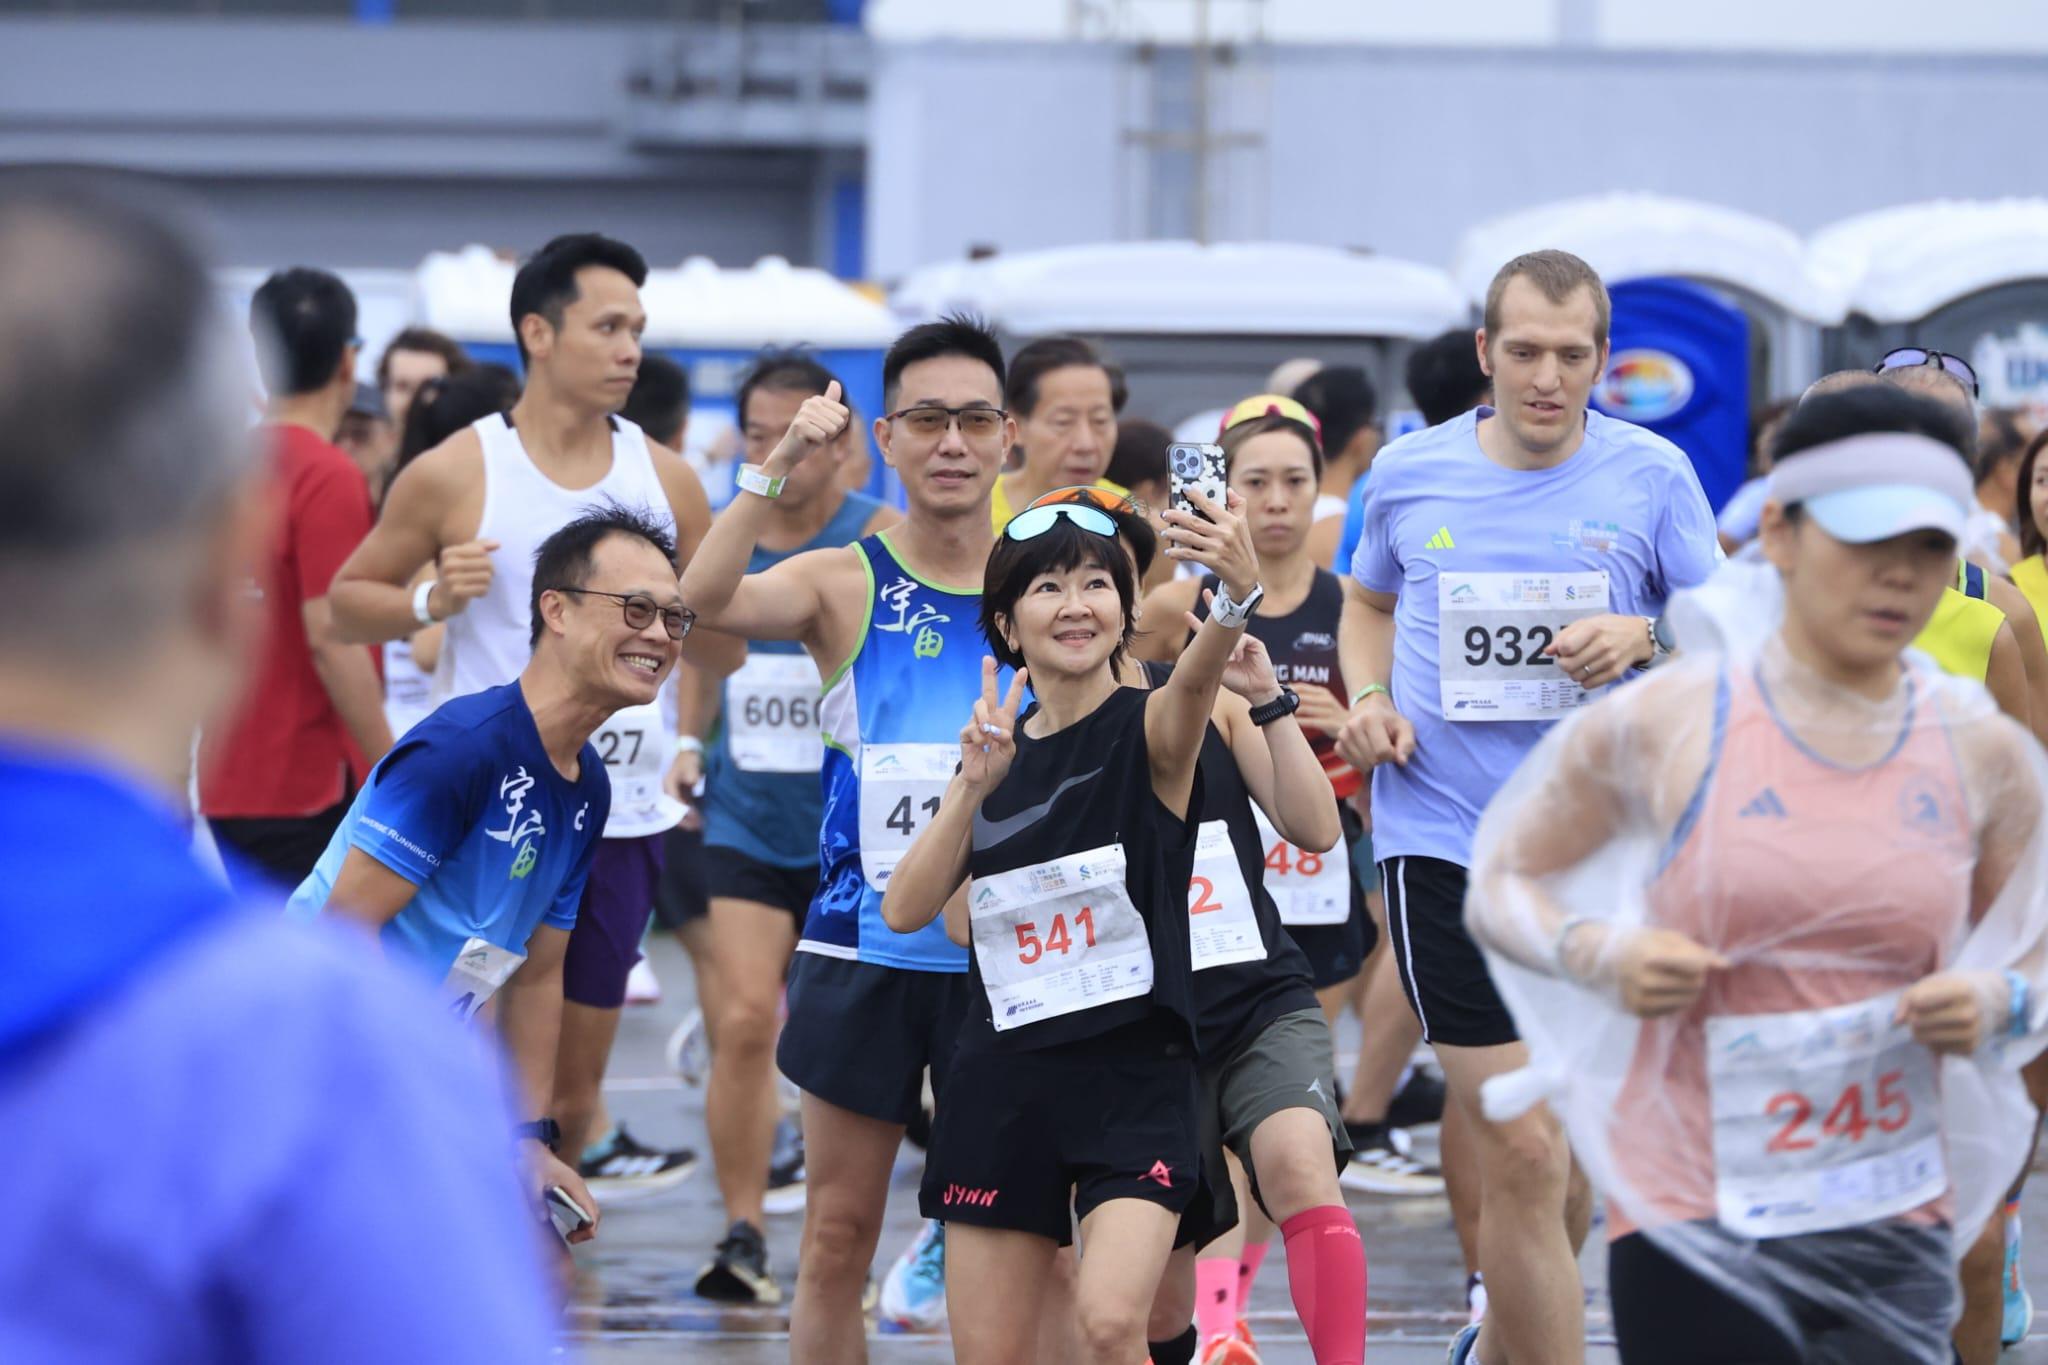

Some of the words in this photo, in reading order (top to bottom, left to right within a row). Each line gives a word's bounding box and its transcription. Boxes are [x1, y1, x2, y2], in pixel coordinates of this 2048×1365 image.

[1464, 626, 1569, 666] 932
[1293, 665, 1329, 683] MAN
[1014, 905, 1097, 965] 541
[1765, 1072, 1911, 1154] 245
[943, 1183, 999, 1207] JYNN
